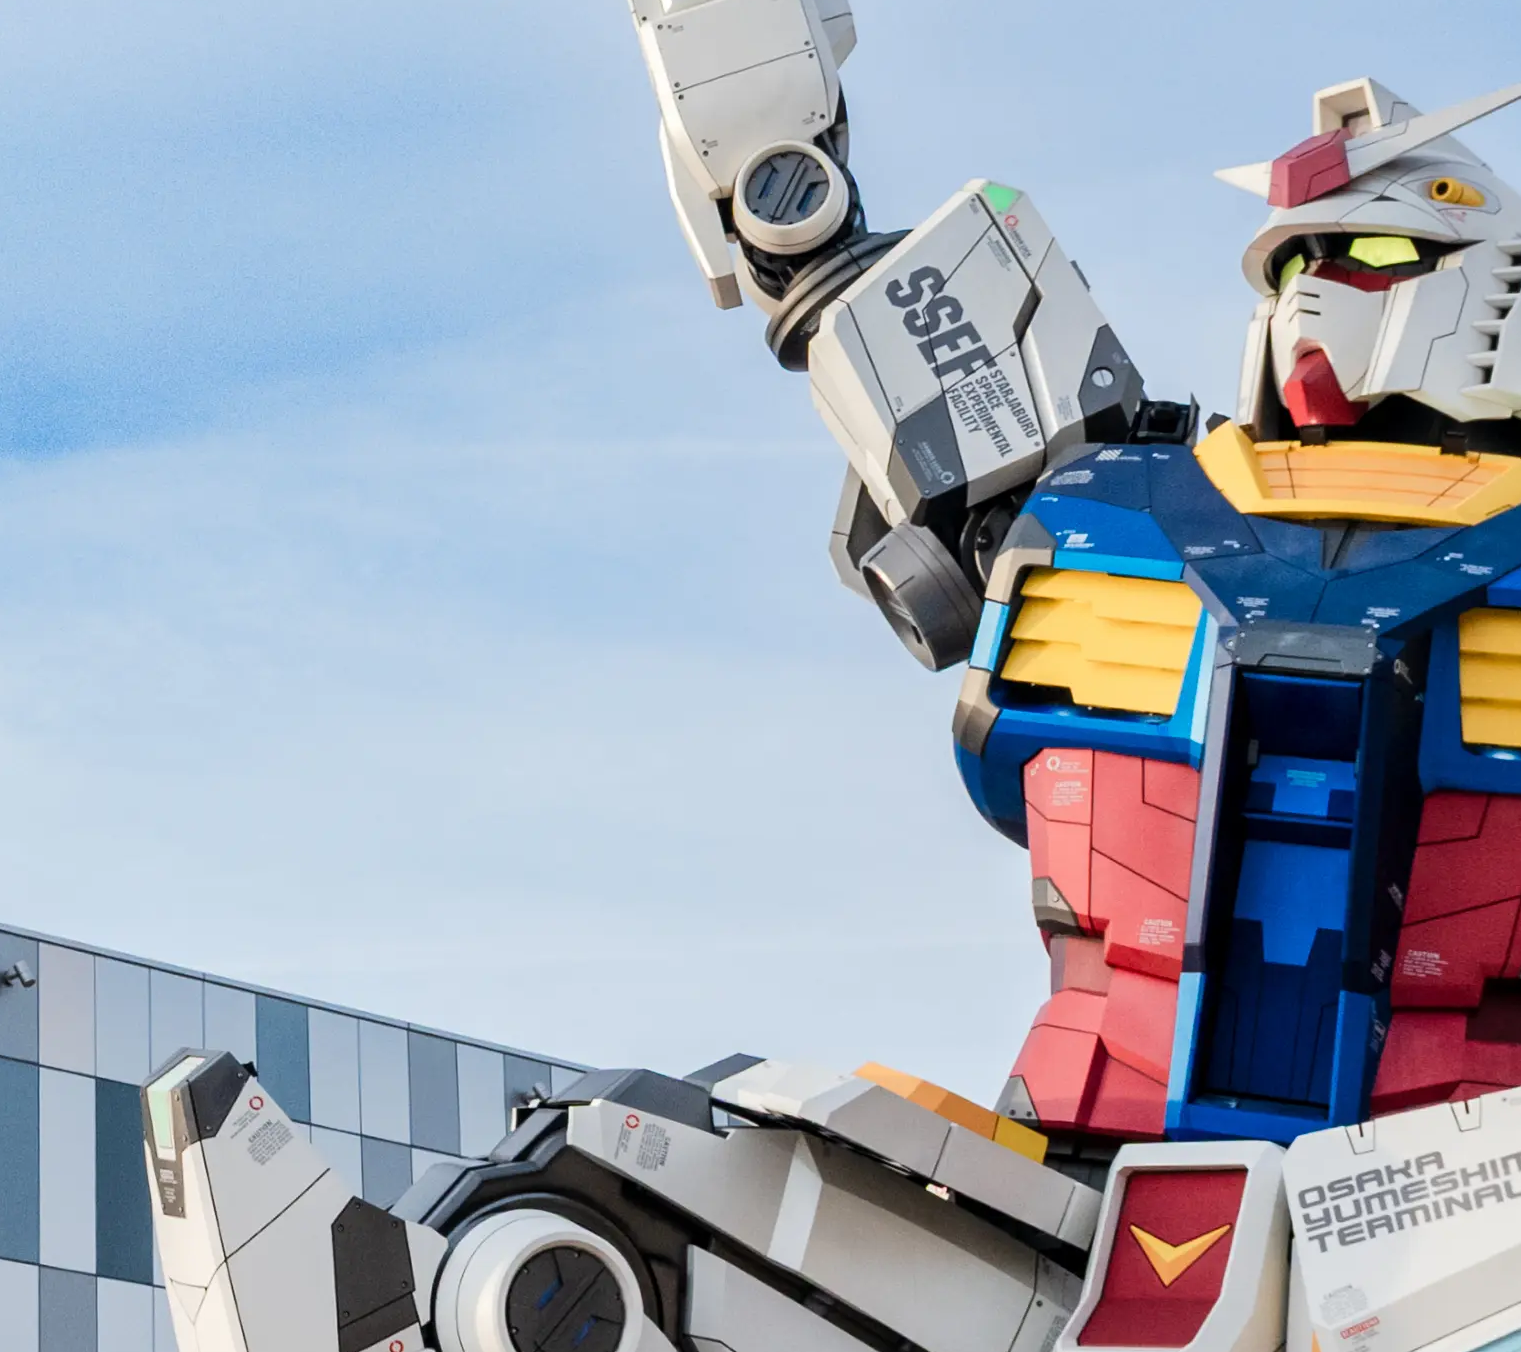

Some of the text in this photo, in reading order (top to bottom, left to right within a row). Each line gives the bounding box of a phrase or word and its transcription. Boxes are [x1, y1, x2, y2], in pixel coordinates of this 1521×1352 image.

[885, 265, 997, 379] SSEF
[945, 386, 983, 434] FACILITY
[960, 381, 1013, 458] EXPERIMENTAL
[975, 375, 1005, 411] SPACE
[989, 369, 1039, 438] STARJABURO
[1297, 1151, 1445, 1210] OSAKA
